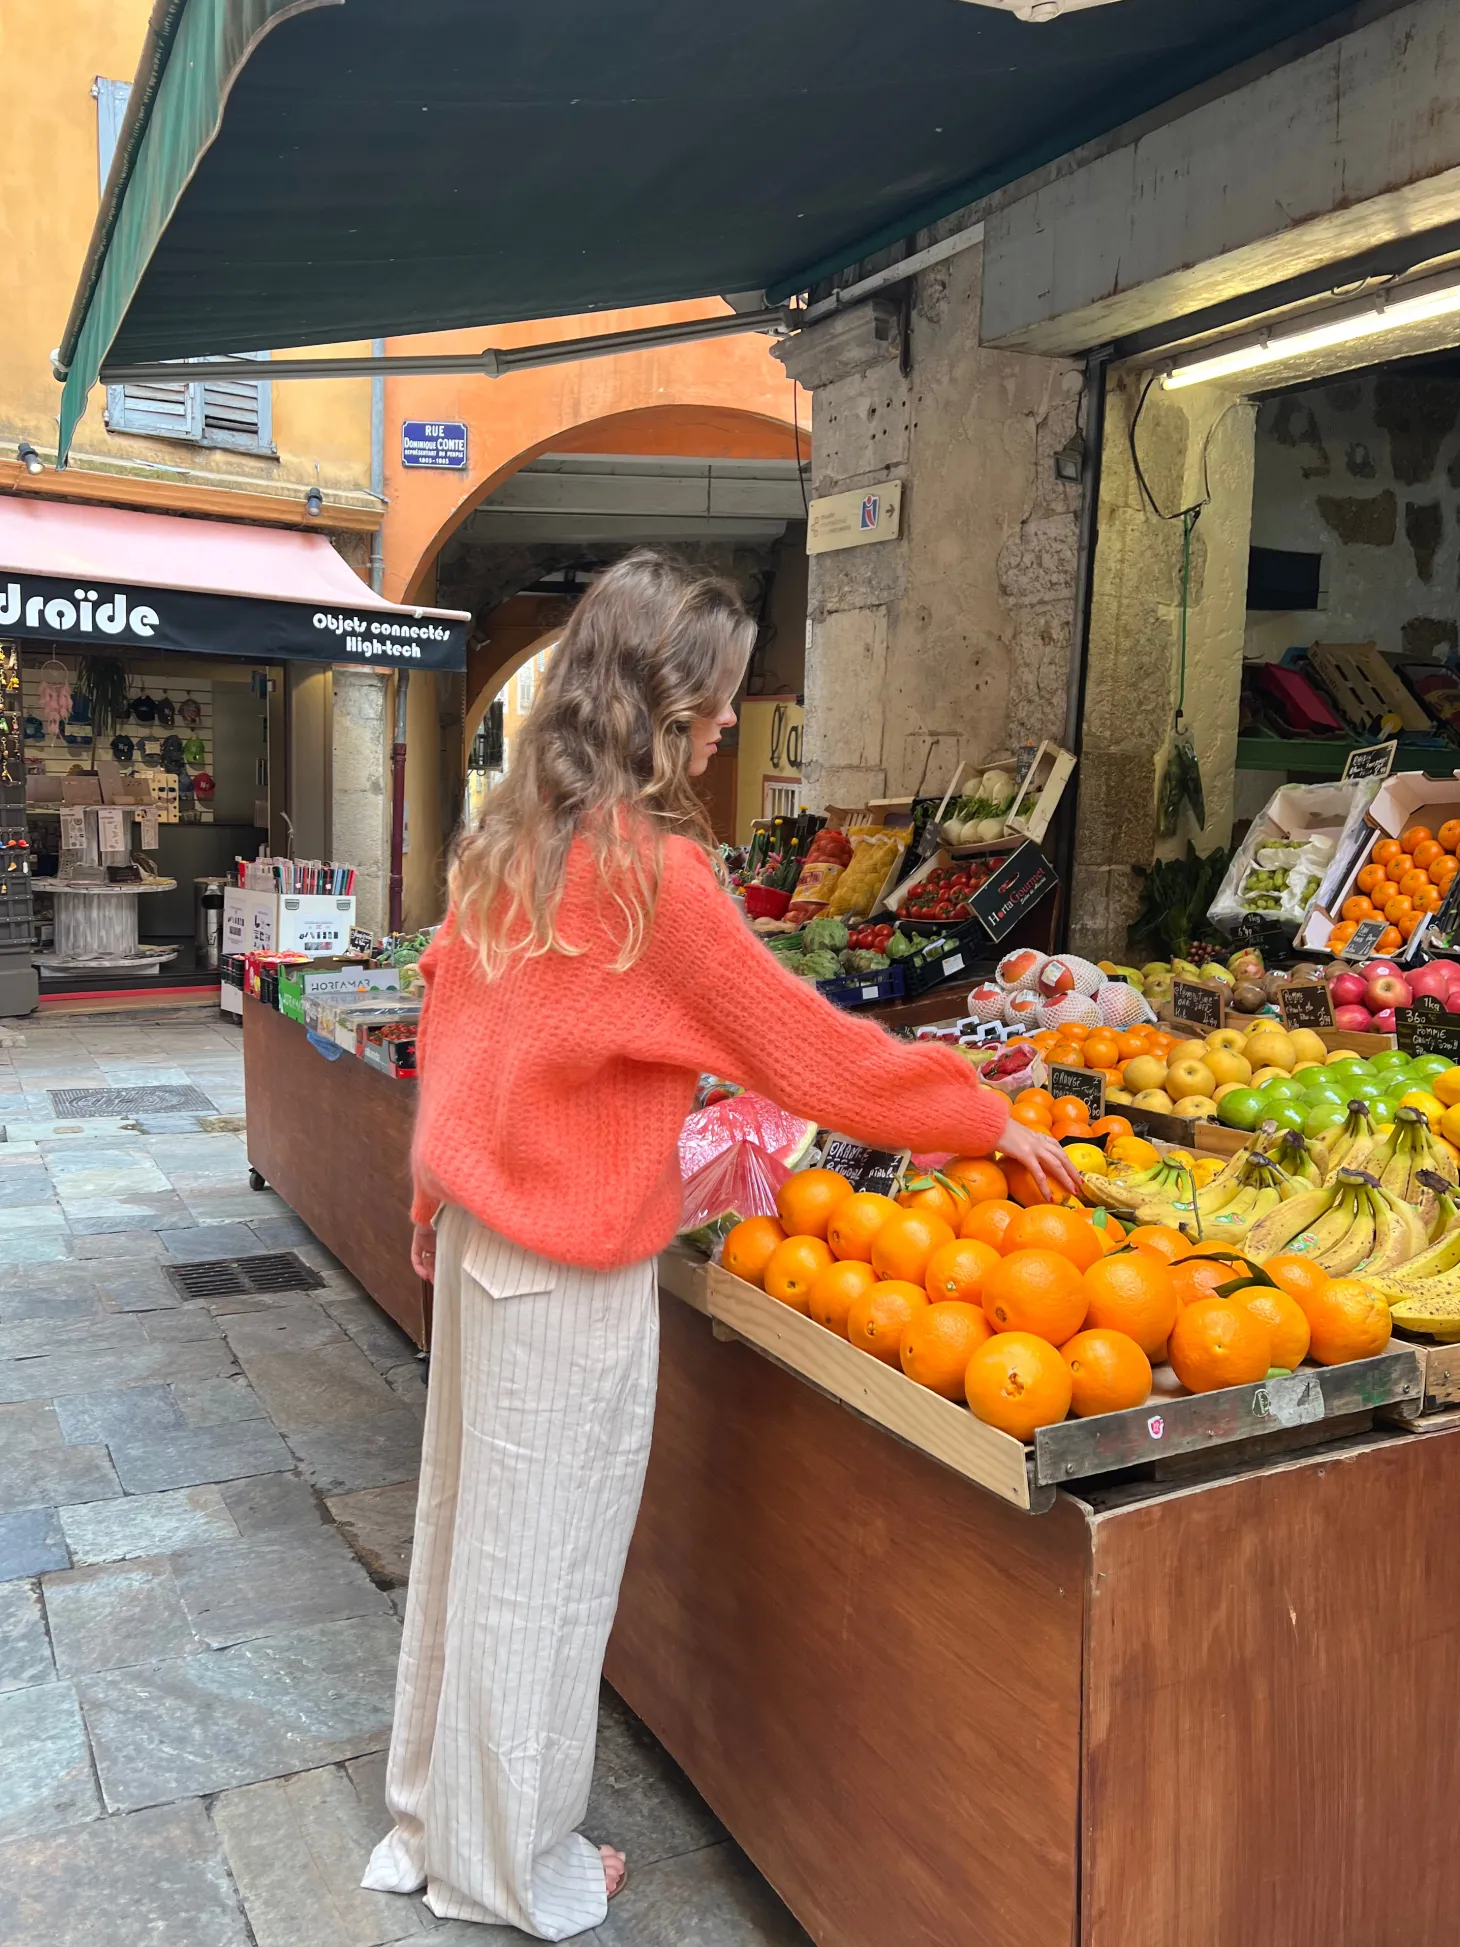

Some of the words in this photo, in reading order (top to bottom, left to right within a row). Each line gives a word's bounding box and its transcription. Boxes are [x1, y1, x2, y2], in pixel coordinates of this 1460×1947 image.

[425, 425, 445, 437] RUE
[312, 613, 367, 635] Objets
[370, 621, 451, 641] connectés
[345, 636, 421, 658] High-tech
[1423, 997, 1440, 1011] 1kg
